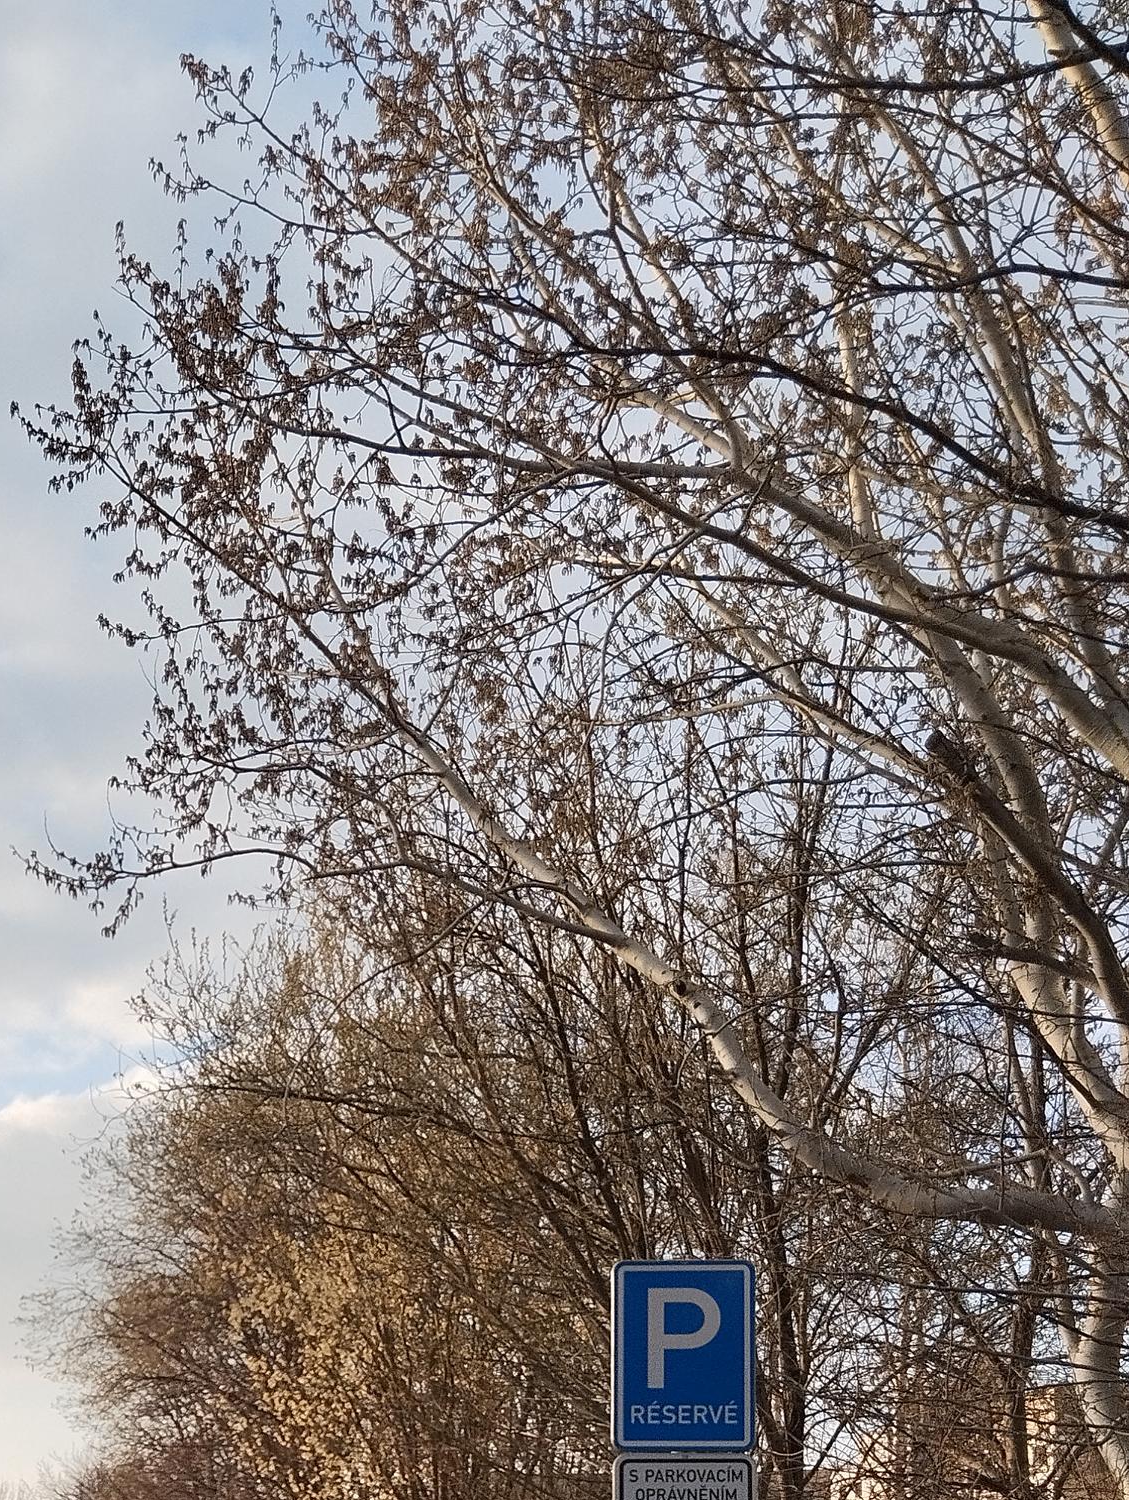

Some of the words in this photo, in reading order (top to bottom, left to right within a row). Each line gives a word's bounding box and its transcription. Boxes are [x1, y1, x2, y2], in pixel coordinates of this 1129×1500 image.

[647, 1287, 722, 1389] P
[631, 1401, 738, 1424] RÉSERVÉ
[629, 1469, 639, 1484] S
[645, 1467, 743, 1483] PARKOVACÍM
